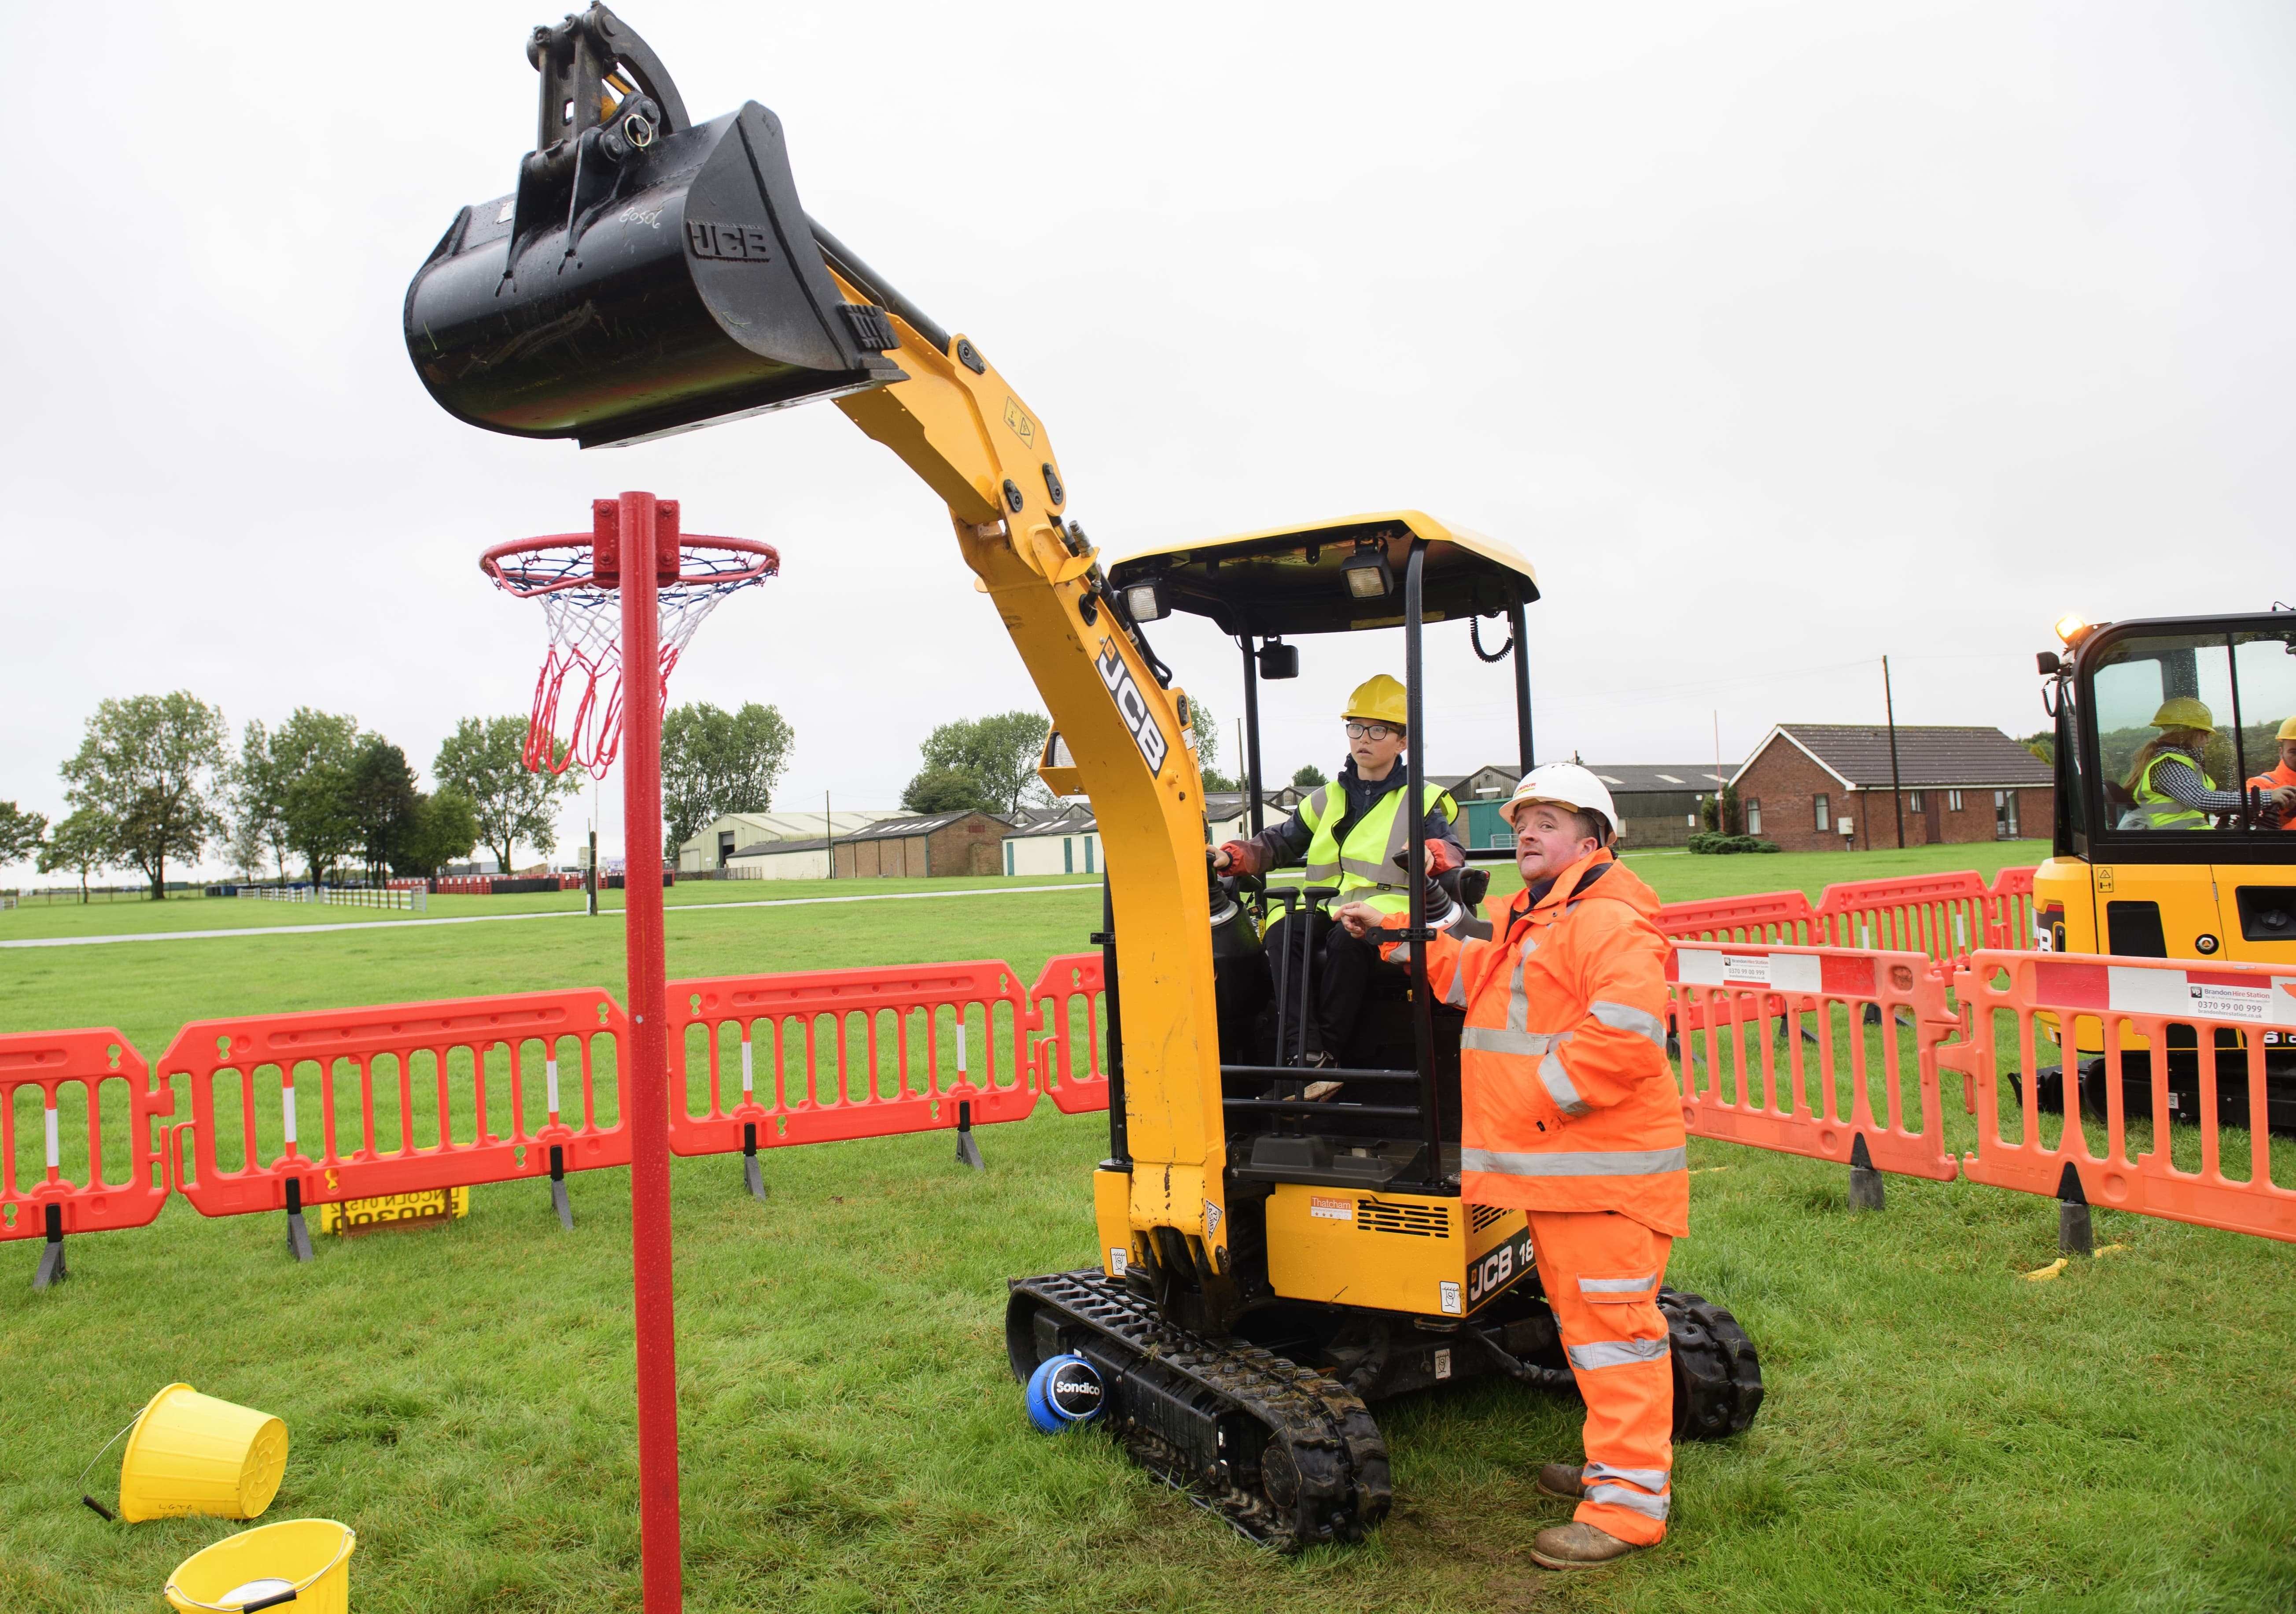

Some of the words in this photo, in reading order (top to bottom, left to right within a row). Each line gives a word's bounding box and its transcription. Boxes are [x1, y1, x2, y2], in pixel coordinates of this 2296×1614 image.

[688, 222, 770, 262] JCB
[1099, 653, 1165, 771] JCB
[2198, 1009, 2262, 1018] brandonhirestation.co.uk
[1312, 1197, 1351, 1209] Thatcham
[1470, 1245, 1512, 1301] JCB
[1056, 1381, 1100, 1396] Sondico
